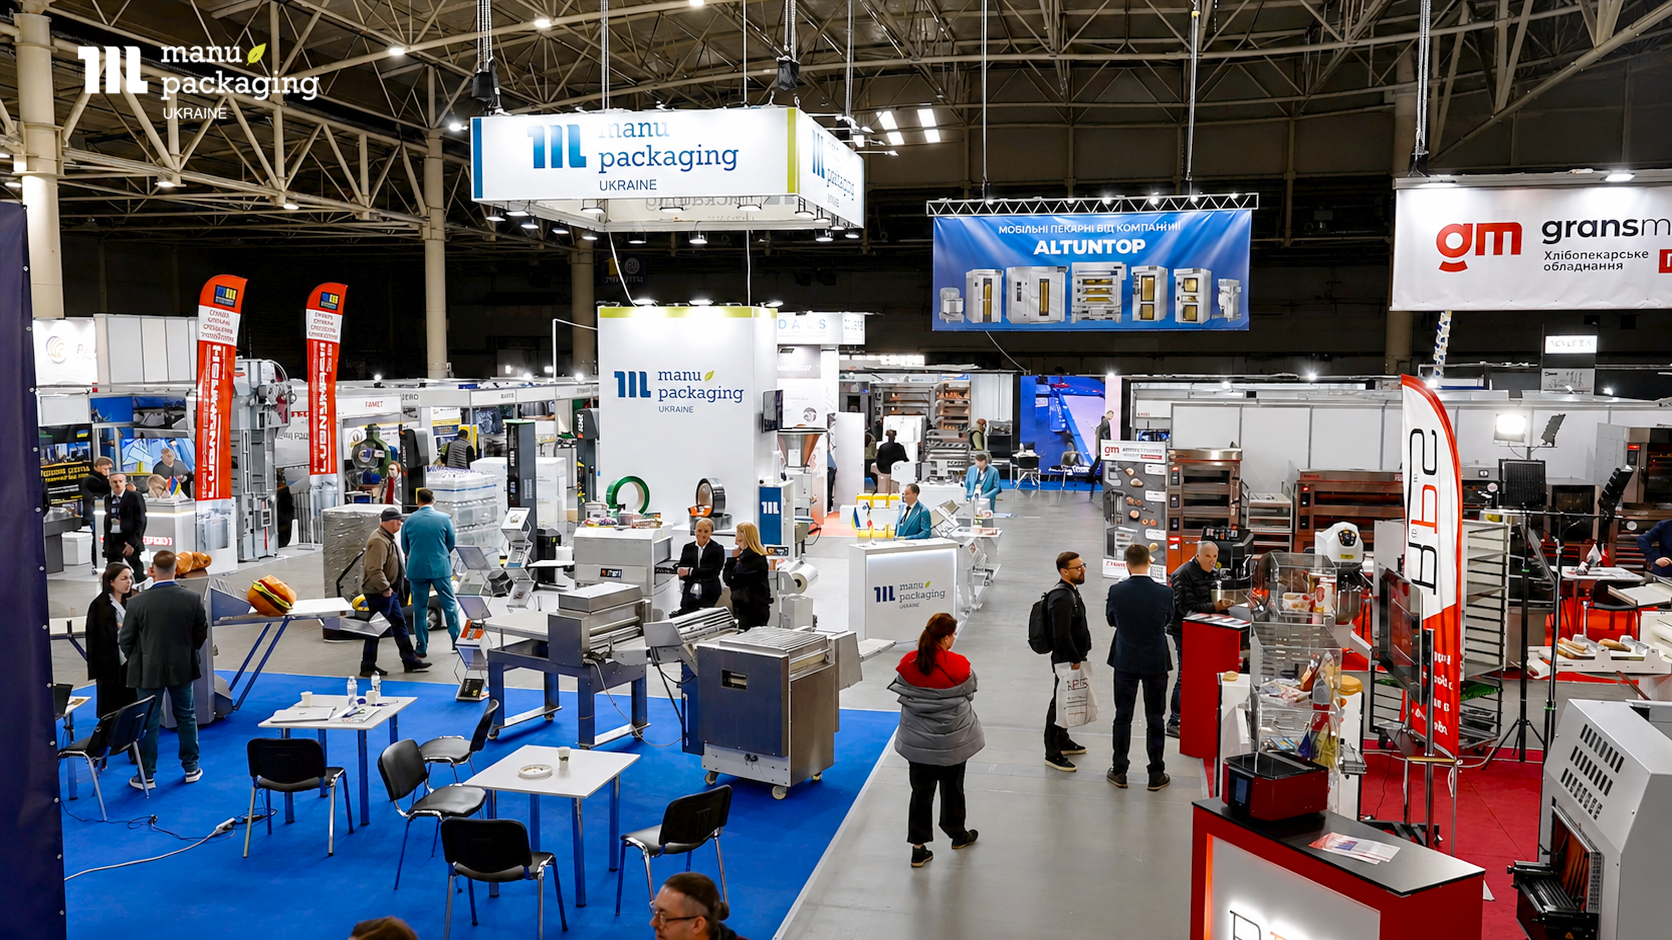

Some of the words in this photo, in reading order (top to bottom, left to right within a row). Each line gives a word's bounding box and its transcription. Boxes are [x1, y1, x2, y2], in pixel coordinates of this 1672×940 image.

[598, 144, 739, 174] packaging
[599, 178, 657, 191] UKRAINE
[998, 224, 1048, 235] МОБІЛЬНІ
[1050, 224, 1094, 234] ПЕКАРНІ
[1033, 238, 1146, 255] ALTUNTOP
[1436, 221, 1523, 273] gm
[1544, 250, 1649, 262] Хлібопекарське
[1543, 261, 1624, 272] обладнання
[657, 370, 702, 382] manu
[657, 386, 745, 403] packaging
[658, 405, 694, 413] UKRAINE
[899, 582, 923, 591] manu
[899, 589, 946, 603] packaging
